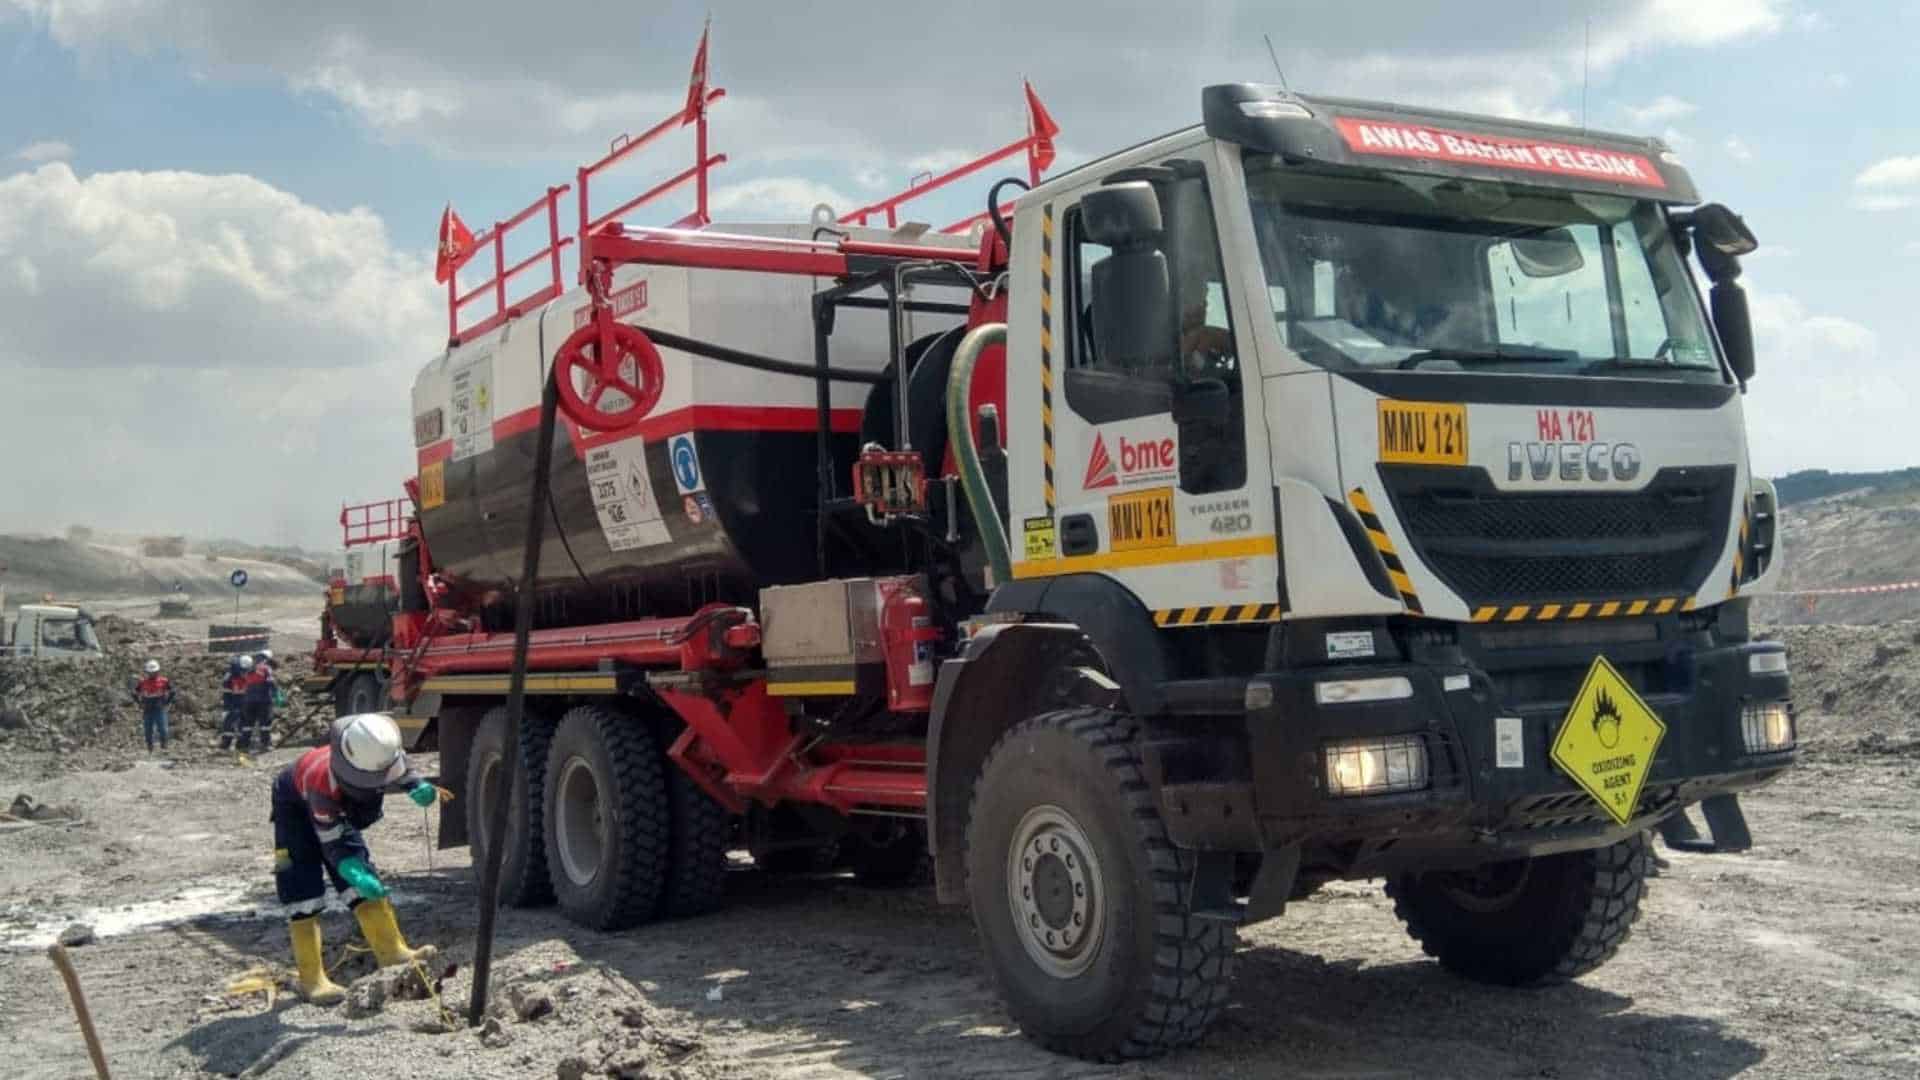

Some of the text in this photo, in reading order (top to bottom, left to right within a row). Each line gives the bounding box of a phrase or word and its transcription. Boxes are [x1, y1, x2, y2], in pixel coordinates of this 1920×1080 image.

[1358, 124, 1441, 154] AWAS
[1540, 146, 1648, 179] PELEDAK
[1383, 410, 1465, 456] MMU 121
[1536, 409, 1596, 441] HA 121
[1120, 436, 1175, 472] bme
[1507, 442, 1642, 483] IVECO
[1112, 497, 1173, 543] MMU 121
[1210, 513, 1251, 534] 420
[1603, 772, 1632, 790] AGENT
